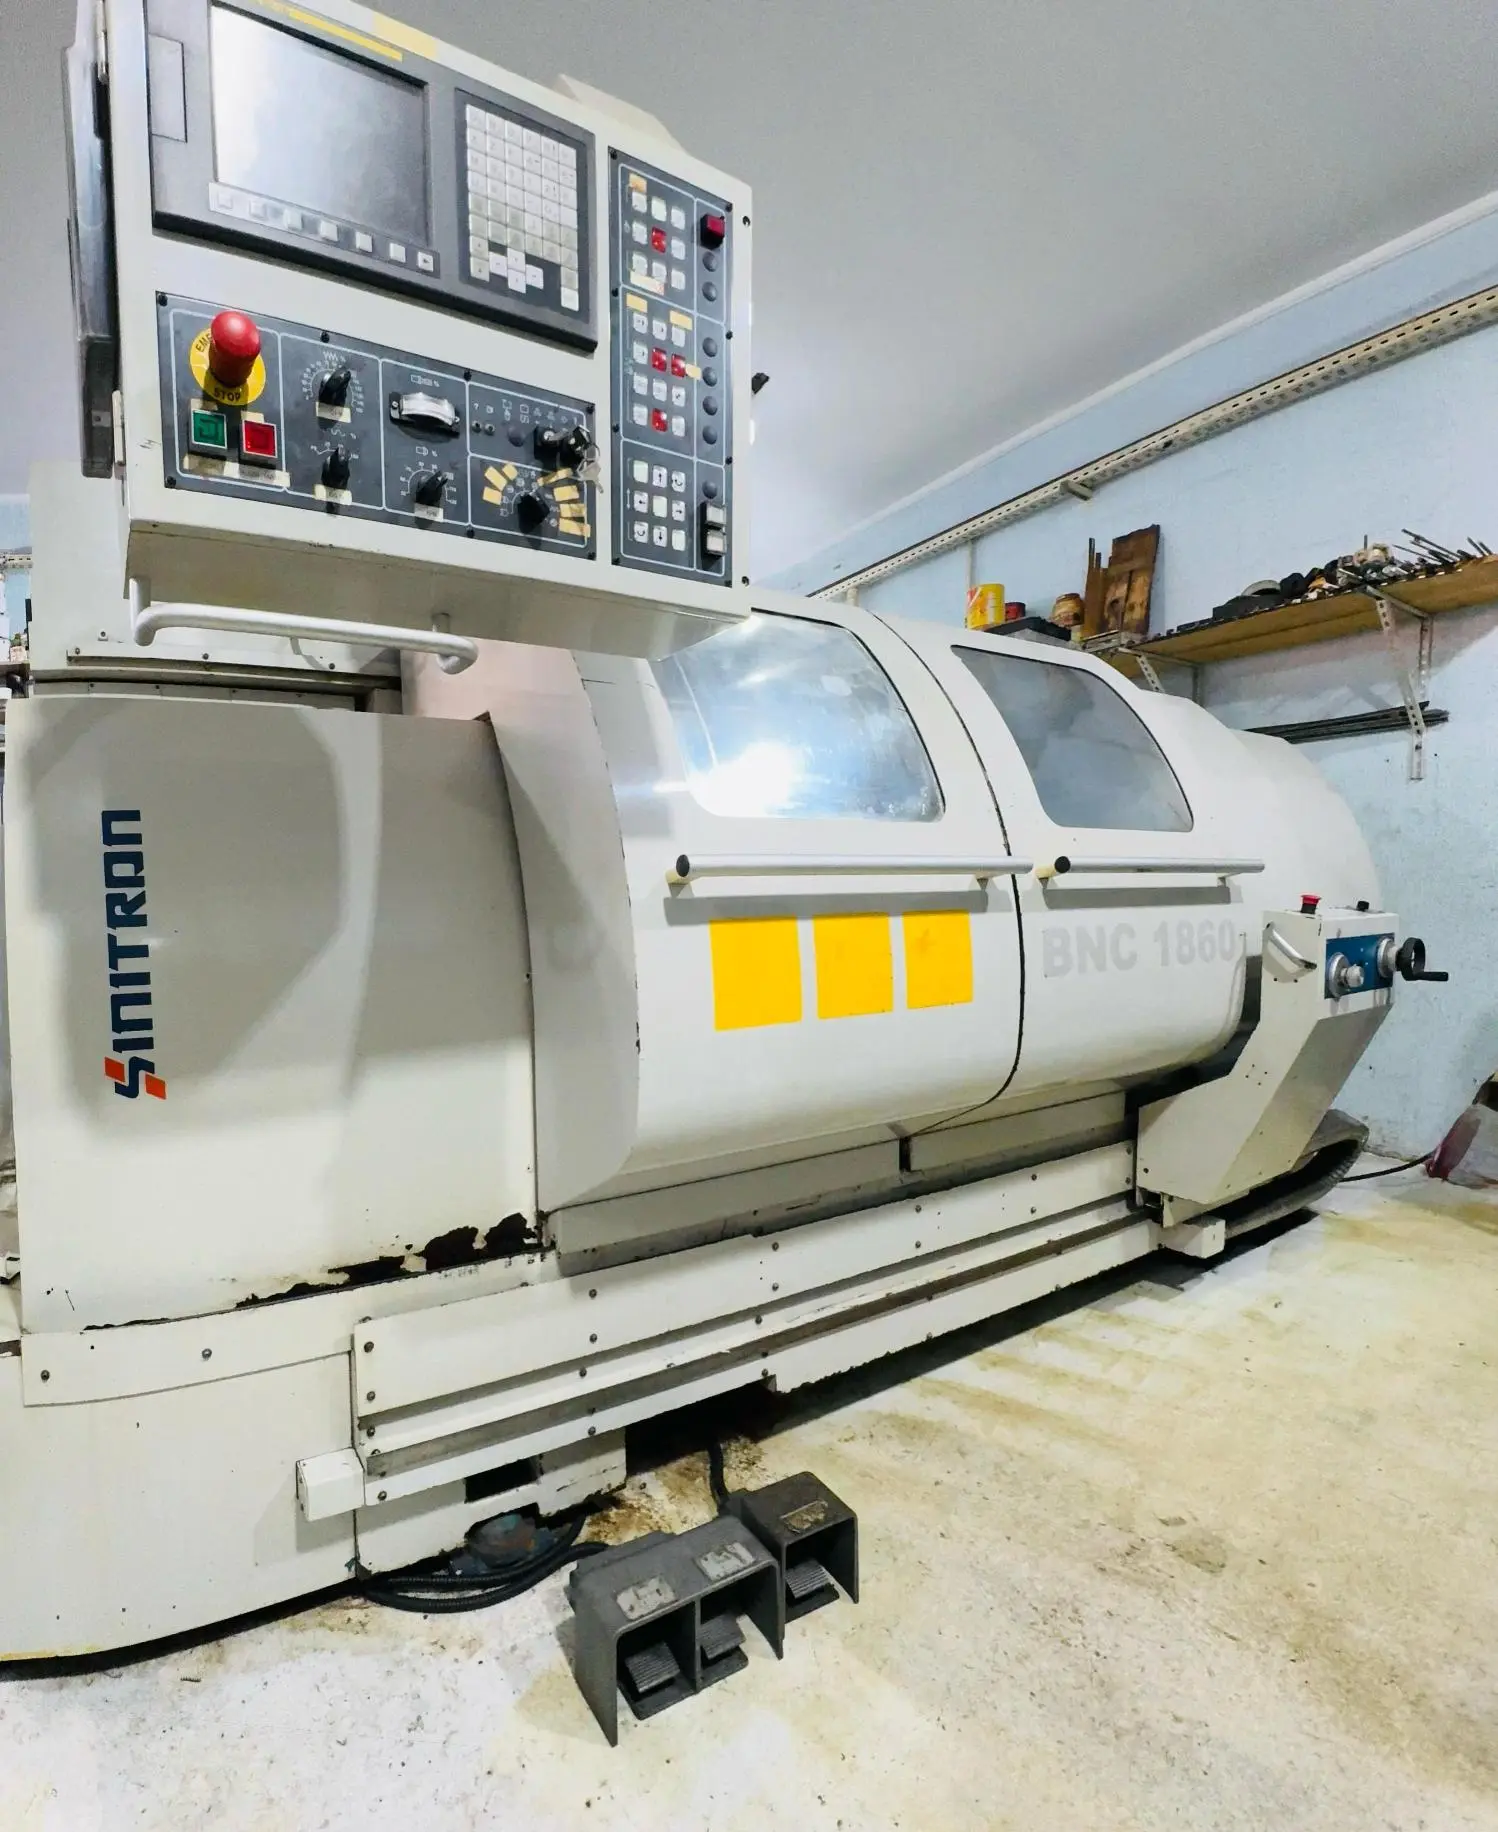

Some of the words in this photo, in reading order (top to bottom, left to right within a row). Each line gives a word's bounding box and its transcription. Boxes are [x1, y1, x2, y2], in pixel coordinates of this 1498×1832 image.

[214, 387, 241, 402] STOP
[1042, 922, 1138, 978] BNC
[1153, 918, 1236, 967] 1860
